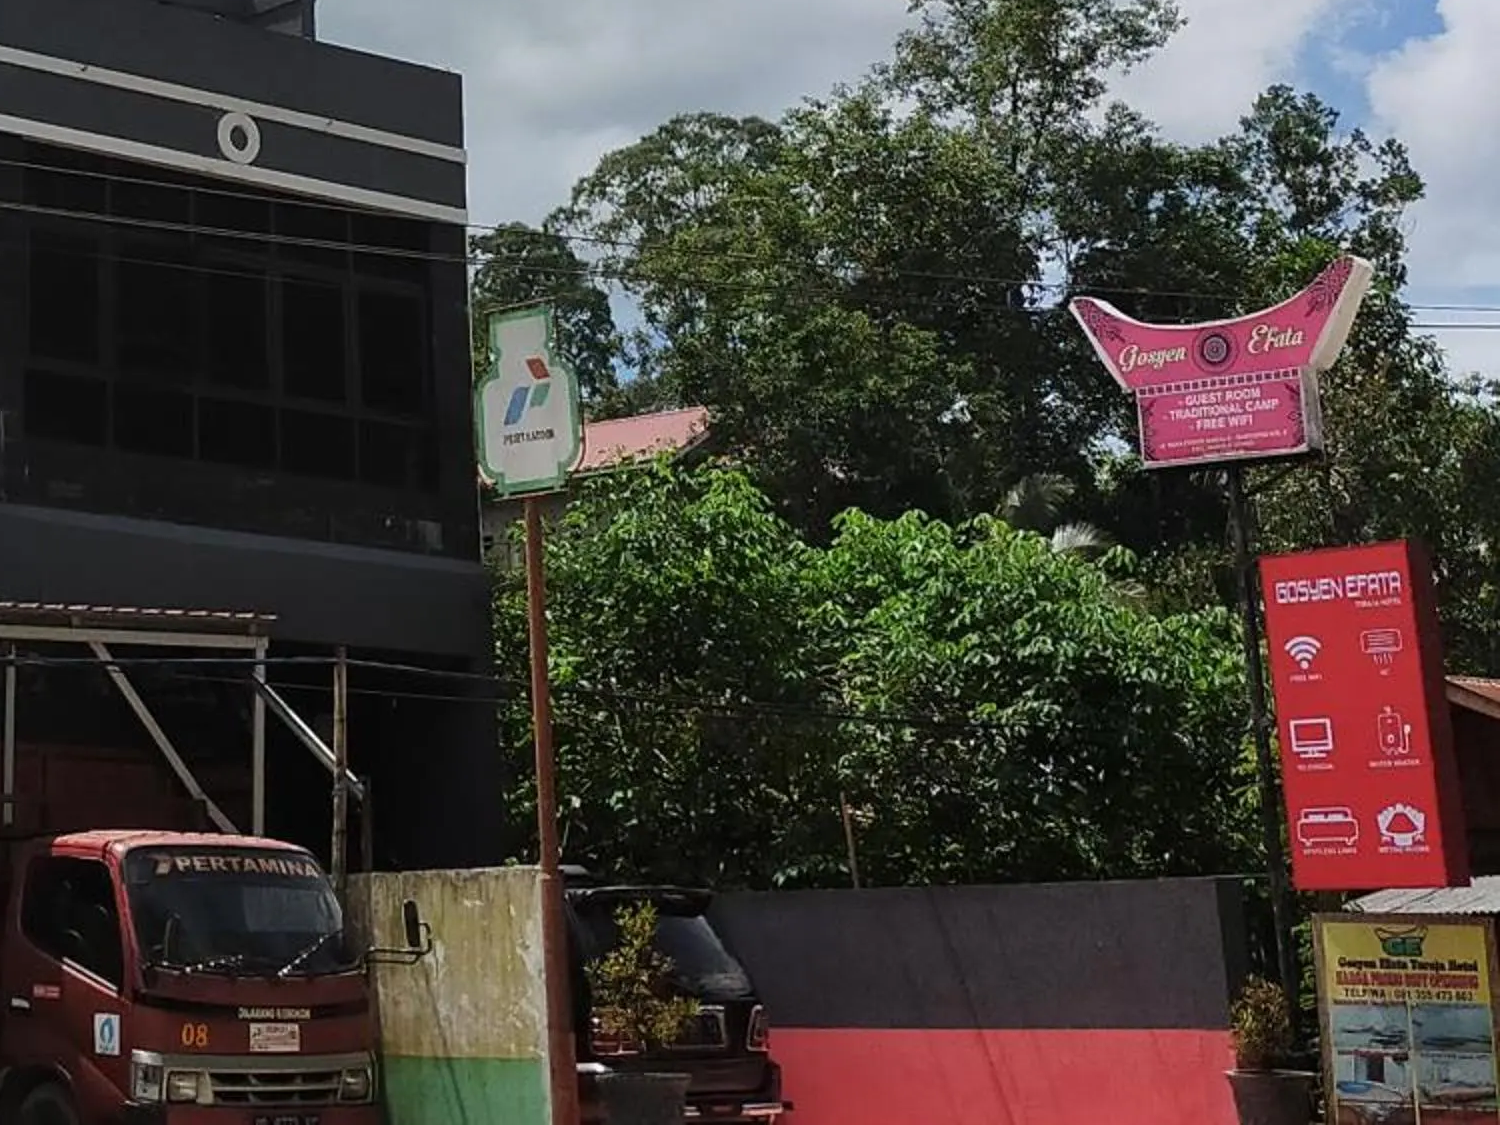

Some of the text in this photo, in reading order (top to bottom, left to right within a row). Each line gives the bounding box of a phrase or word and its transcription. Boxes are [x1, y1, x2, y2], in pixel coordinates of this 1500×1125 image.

[1225, 387, 1261, 401] ROOM
[1275, 570, 1401, 604] GOSYEN EFATA
[176, 855, 321, 878] PERTAMINA
[182, 1022, 209, 1047] 08
